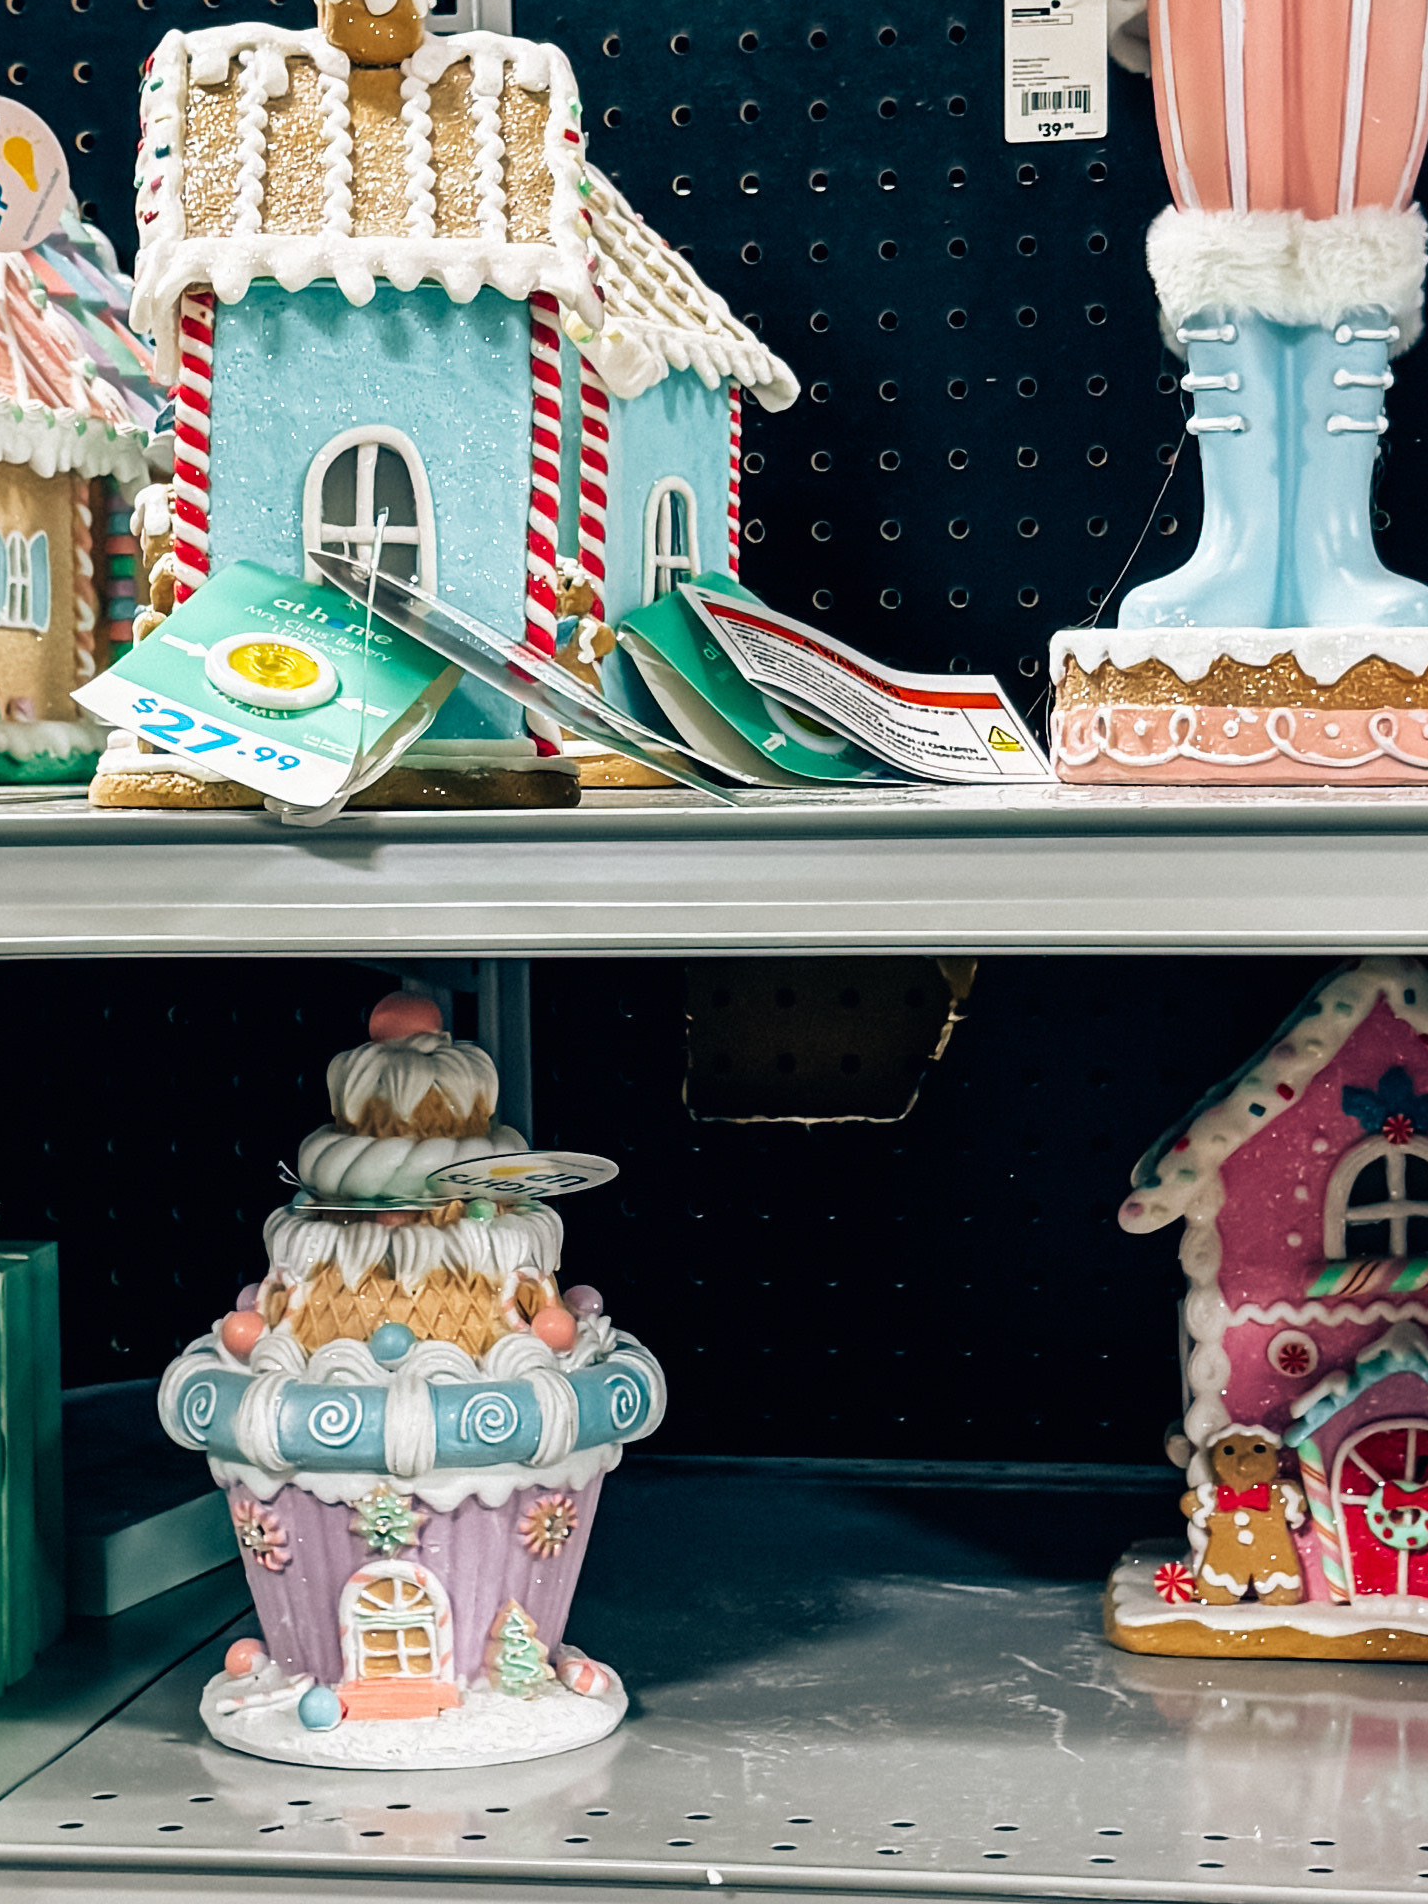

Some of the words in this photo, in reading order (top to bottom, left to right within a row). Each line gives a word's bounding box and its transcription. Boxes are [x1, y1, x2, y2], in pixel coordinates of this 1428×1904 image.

[273, 598, 305, 619] at
[335, 636, 392, 663] Bakery
[132, 698, 301, 771] $27.99
[525, 1173, 589, 1188] UP
